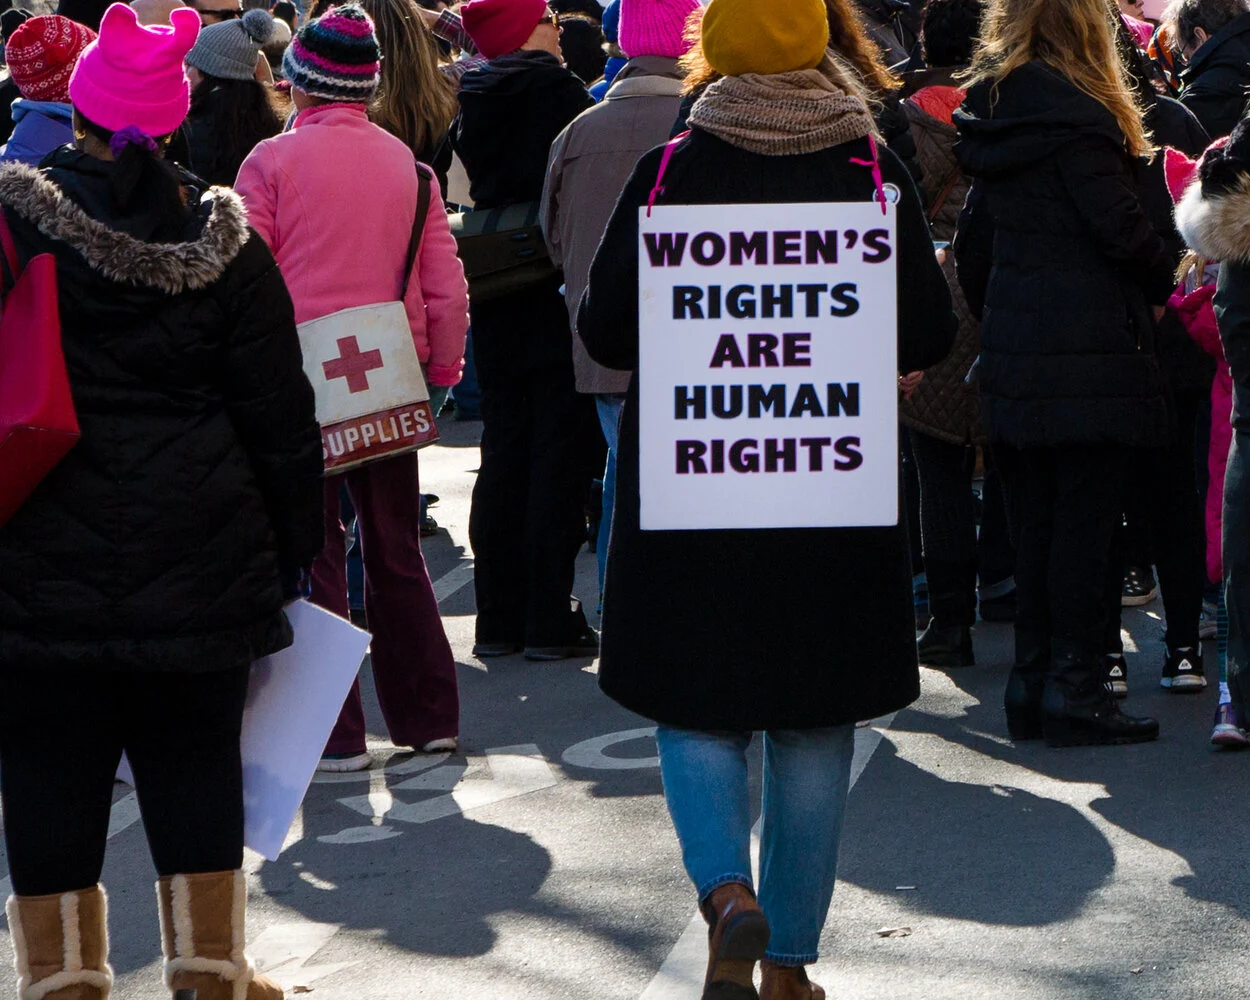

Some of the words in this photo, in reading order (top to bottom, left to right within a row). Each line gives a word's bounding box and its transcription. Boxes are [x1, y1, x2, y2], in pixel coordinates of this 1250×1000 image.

[642, 228, 892, 267] WOMEN'S
[672, 282, 861, 320] RIGHTS
[709, 332, 812, 368] ARE
[674, 382, 860, 420] HUMAN
[675, 435, 864, 475] RIGHTS
